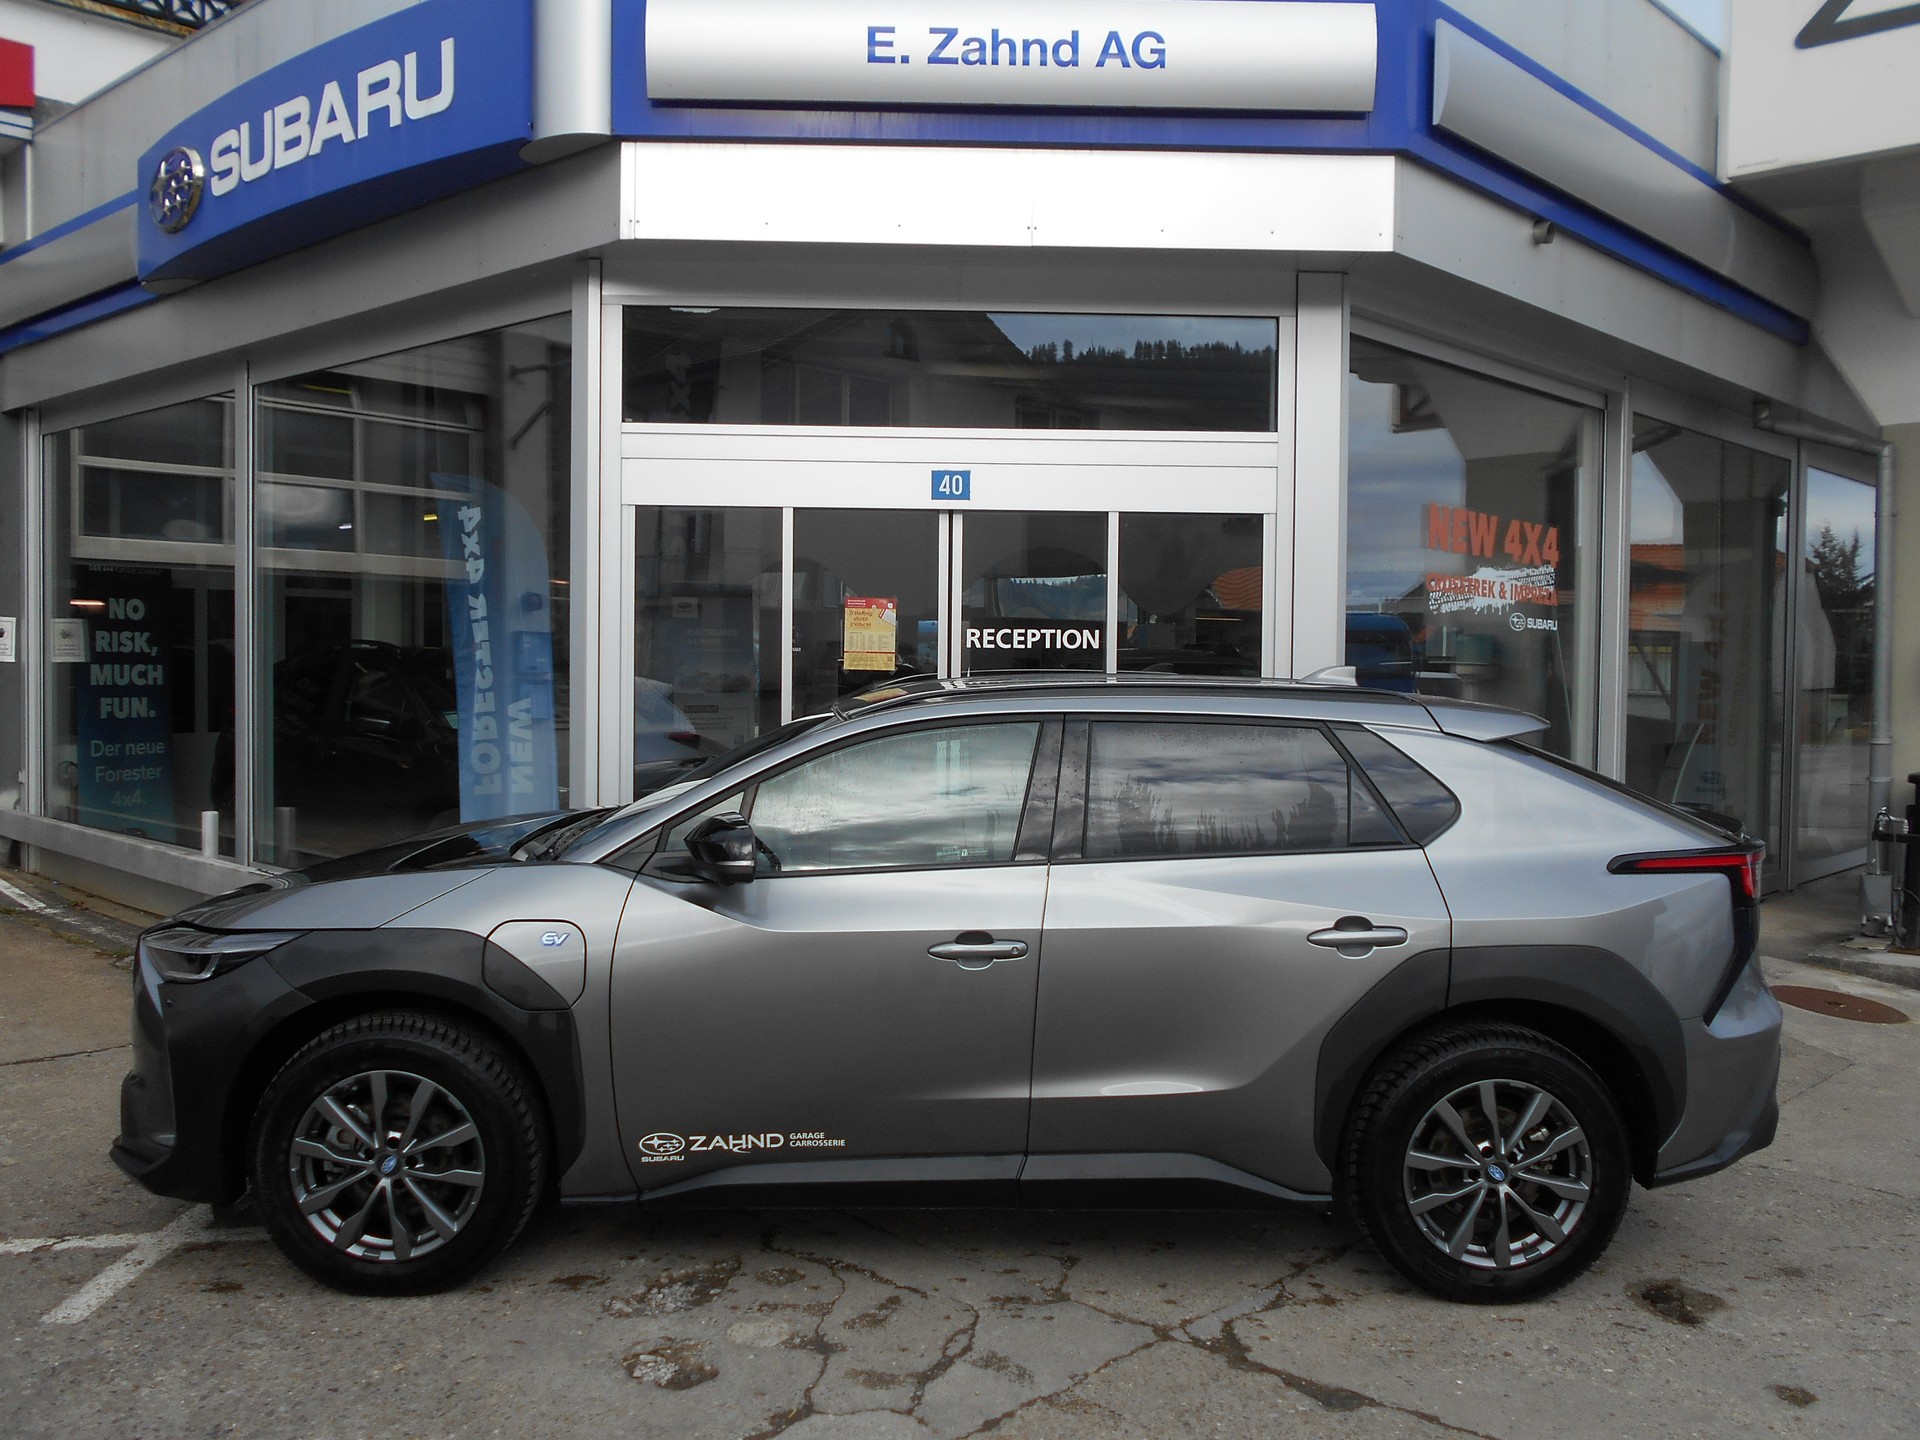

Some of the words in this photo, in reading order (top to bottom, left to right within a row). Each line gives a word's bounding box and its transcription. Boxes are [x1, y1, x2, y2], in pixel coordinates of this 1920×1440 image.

[867, 25, 910, 64] E.
[927, 26, 1080, 68] Zahnd
[1095, 30, 1167, 70] AG
[210, 37, 455, 197] SUBARU
[938, 474, 963, 496] 40
[1428, 501, 1498, 559] NEW
[1504, 519, 1560, 569] 4X4
[1425, 572, 1496, 599] CROSSTREK
[1499, 581, 1507, 600] &
[1510, 582, 1559, 606] IMPREZA
[108, 597, 146, 620] NO
[1527, 617, 1558, 631] SUBARU
[95, 630, 159, 656] RISK,
[966, 628, 1100, 649] RECEPTION
[90, 663, 164, 686] MUCH
[100, 697, 157, 719] FUN.
[90, 740, 121, 757] Der
[126, 741, 165, 755] neue
[95, 765, 162, 783] Forester
[540, 931, 571, 946] EV
[689, 1133, 784, 1153] ZAHND
[789, 1138, 846, 1148] CARROSSERIE
[789, 1132, 825, 1140] GARAGE
[641, 1154, 685, 1163] SUBARU
